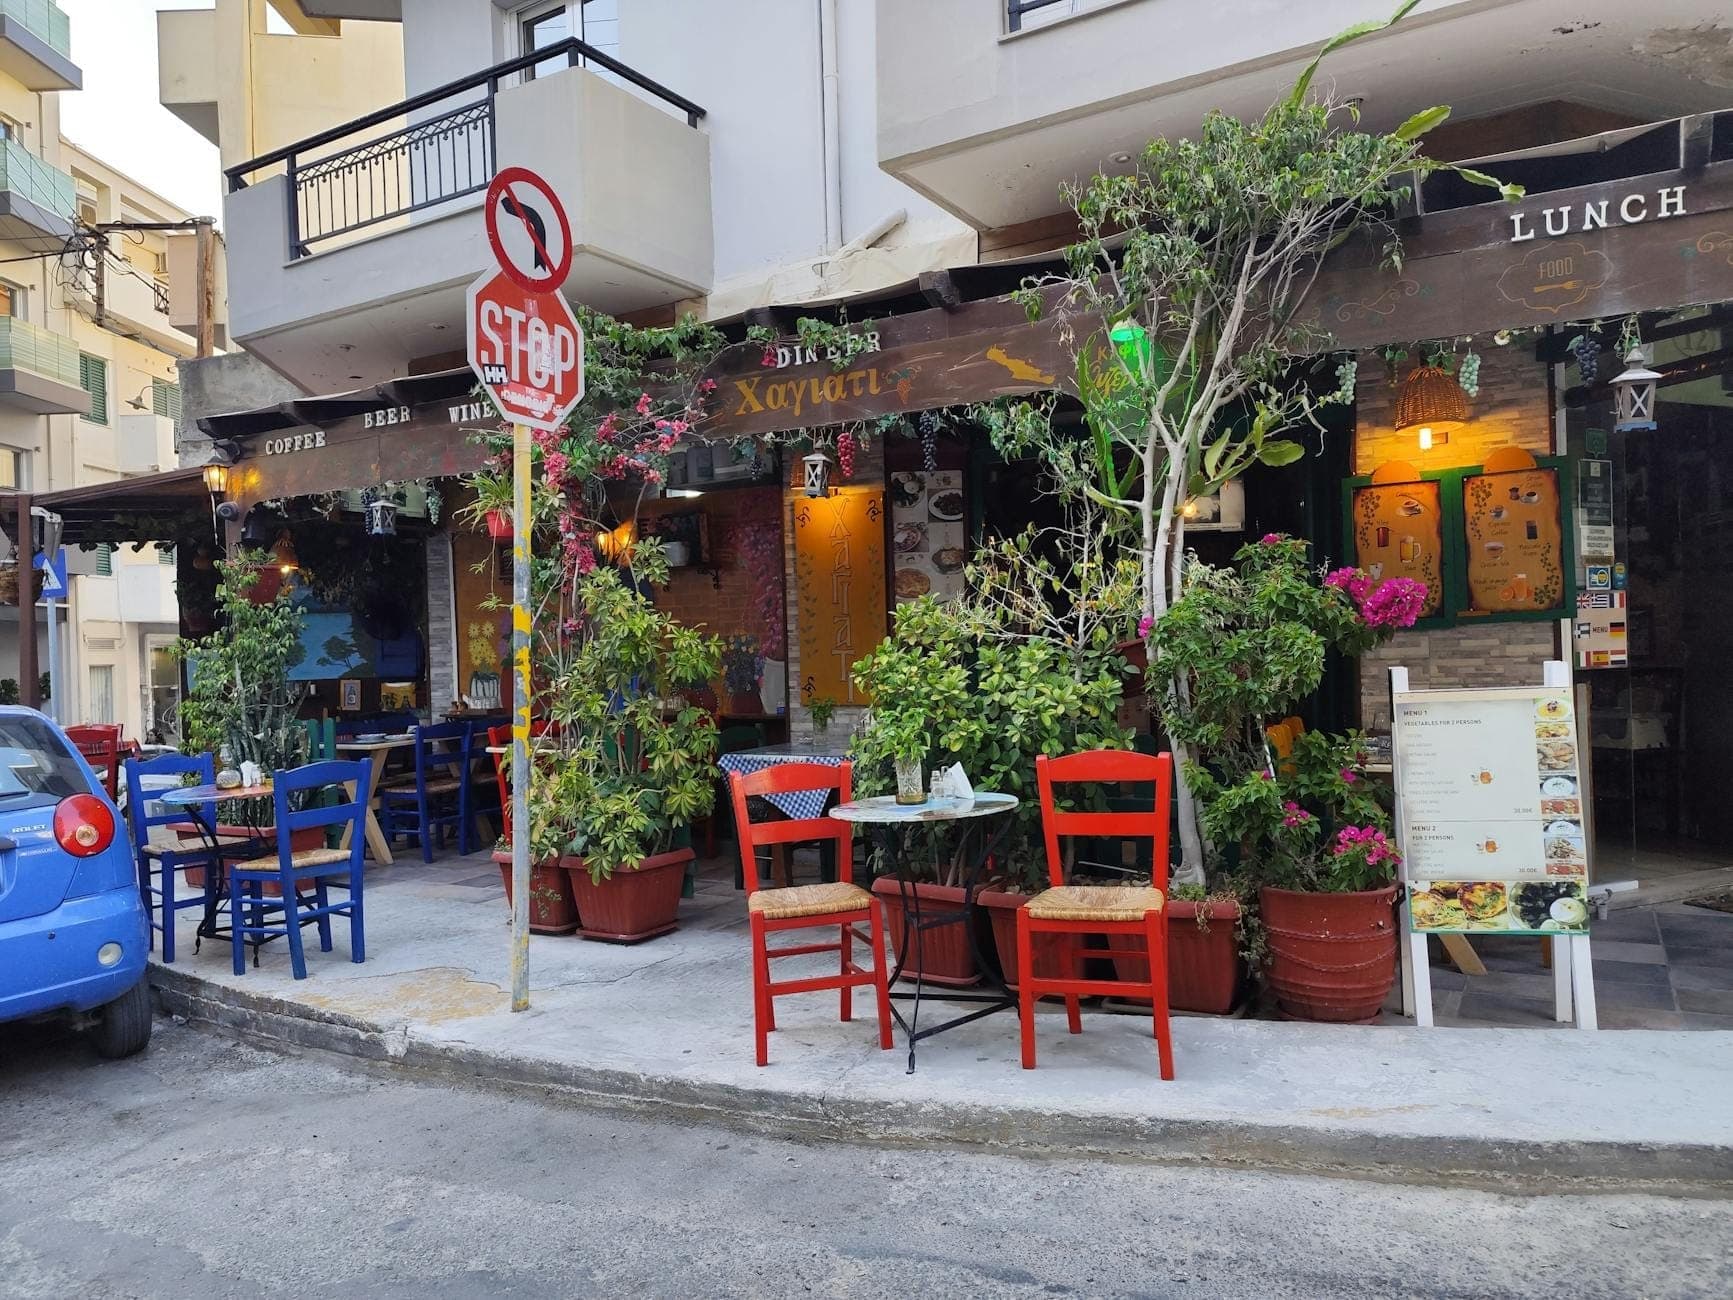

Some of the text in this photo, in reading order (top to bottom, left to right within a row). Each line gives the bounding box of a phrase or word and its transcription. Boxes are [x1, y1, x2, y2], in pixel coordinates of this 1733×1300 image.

[1510, 186, 1687, 242] LUNCH
[1539, 257, 1573, 279] FOOD
[480, 299, 576, 396] STOP
[364, 406, 411, 429] BEER
[448, 401, 493, 424] WINE
[265, 431, 327, 455] COFFEE
